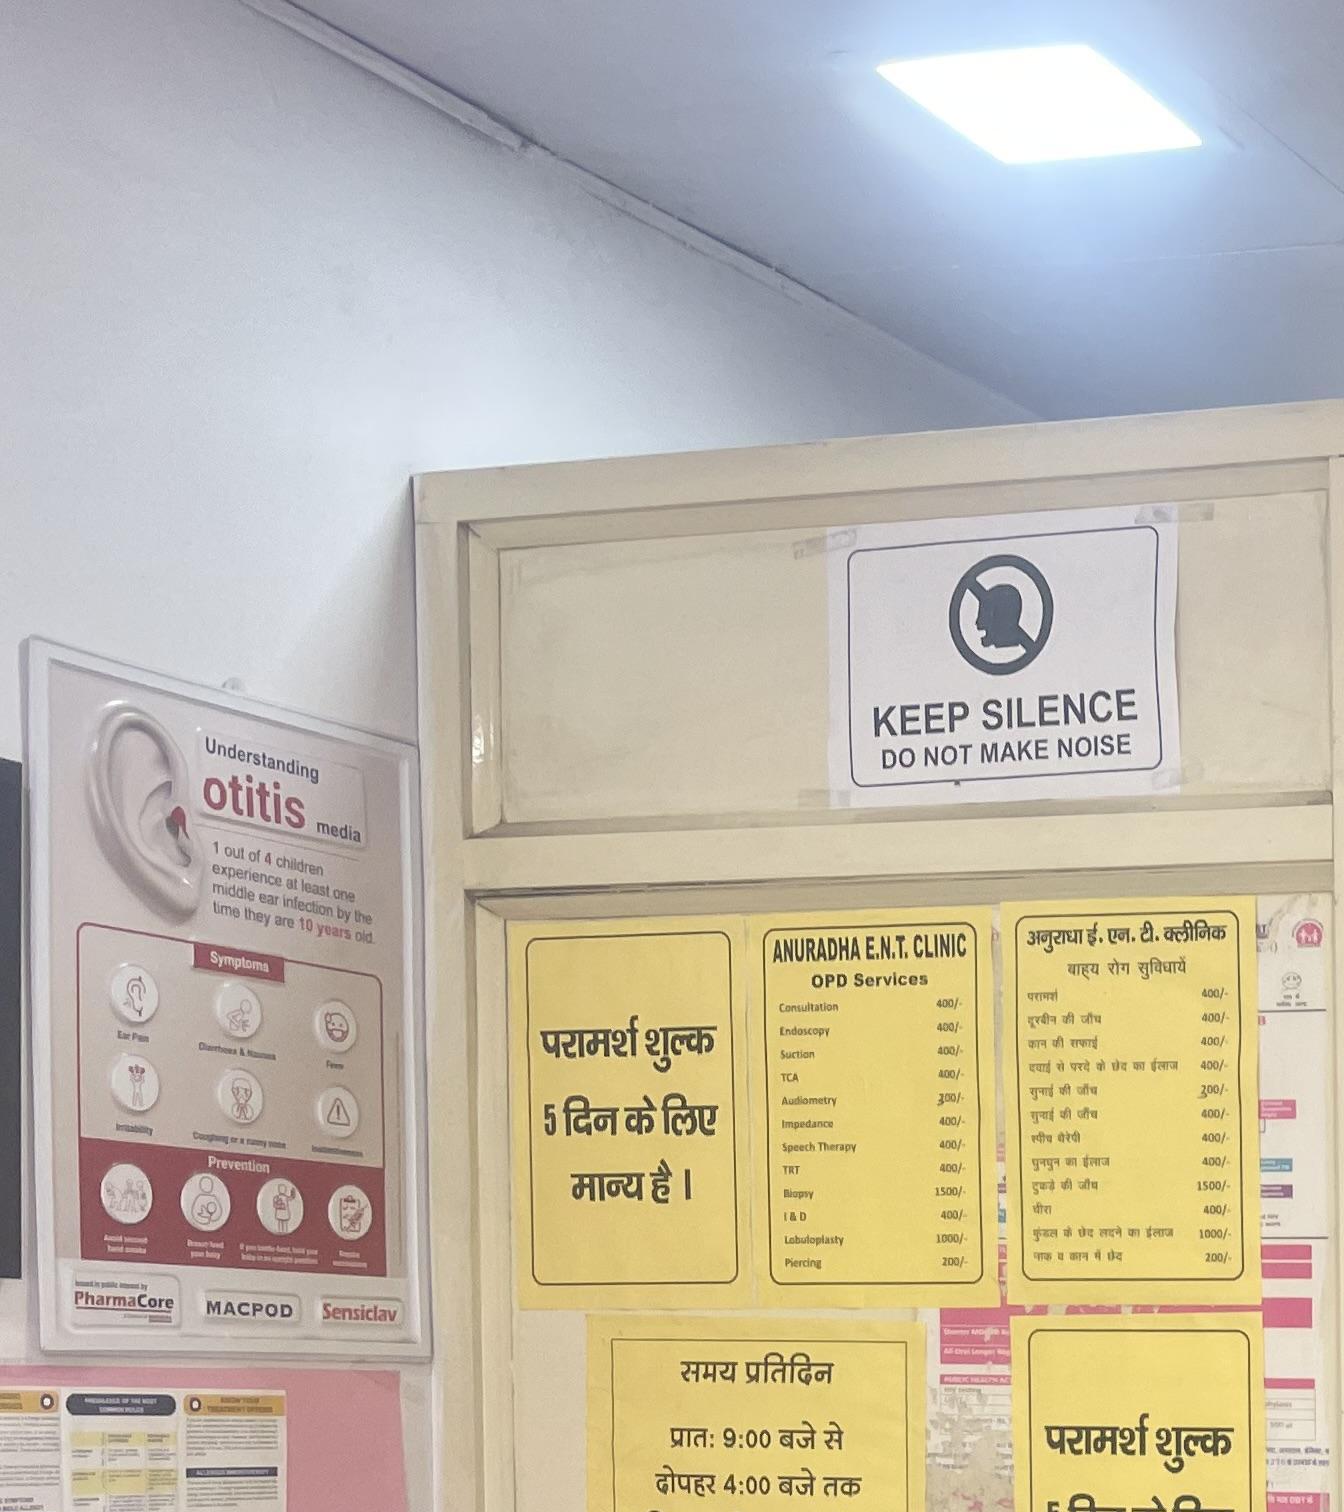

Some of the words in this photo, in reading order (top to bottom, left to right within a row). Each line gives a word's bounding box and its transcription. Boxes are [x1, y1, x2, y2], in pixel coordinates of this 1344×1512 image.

[874, 702, 969, 737] KEEP
[983, 689, 1137, 730] SILENCE
[206, 737, 319, 784] Understanding
[882, 748, 915, 769] DO
[925, 744, 972, 766] NOT
[981, 740, 1048, 763] MAKE
[1058, 734, 1131, 758] NOISE
[204, 775, 305, 828] otitis
[317, 821, 361, 842] media
[213, 842, 219, 853] 1
[224, 846, 244, 859] out
[249, 850, 262, 862] of
[265, 853, 271, 864] 4
[276, 857, 323, 876] children
[213, 864, 282, 887] experience
[287, 878, 297, 889] at
[301, 880, 330, 897] least
[333, 889, 355, 902] one
[213, 882, 255, 900] middle
[259, 892, 278, 905] ear
[283, 895, 333, 916] infection
[337, 908, 351, 923] by
[355, 911, 372, 924] the
[213, 902, 240, 918] time
[245, 908, 270, 927] they
[275, 915, 294, 928] are
[299, 918, 313, 931] 10
[317, 922, 351, 939] years
[773, 937, 860, 962] ANURADHA
[866, 936, 908, 960] E.N.T.
[914, 933, 966, 958] CLINIC
[1027, 929, 1083, 953] अनुराधा
[1164, 920, 1226, 942] क्लीनिक
[210, 951, 269, 973] Symptoms
[1108, 958, 1129, 975] रोग
[812, 974, 847, 988] OPD
[854, 972, 928, 987] Services
[779, 1002, 838, 1013] Consultation
[780, 1026, 829, 1038] Endoscopy
[540, 1015, 638, 1058] परामर्श
[645, 1026, 717, 1073] शुल्क
[781, 1050, 814, 1059] Suction
[781, 1073, 798, 1082] TCA
[782, 1097, 837, 1107] Audiometry
[544, 1104, 556, 1135] 5
[563, 1095, 619, 1136] दिन
[624, 1095, 657, 1135] के
[661, 1093, 718, 1136] लिए
[782, 1120, 833, 1129] Impedance
[782, 1143, 815, 1152] Speech
[819, 1142, 856, 1152] Therapy
[208, 1155, 270, 1174] Prevention
[783, 1166, 800, 1174] TRT
[571, 1173, 645, 1201] मान्य
[784, 1189, 813, 1199] Biopsy
[785, 1235, 844, 1246] Lobuloplasty
[785, 1258, 821, 1269] Piercing
[75, 1291, 174, 1309] PharmaCore
[206, 1300, 293, 1318] MACPOD
[322, 1303, 397, 1322] Sensiclav
[681, 1361, 738, 1383] समय
[746, 1352, 834, 1385] प्रतिदिन
[724, 1428, 771, 1448] 9:00
[779, 1421, 816, 1449] बजे
[824, 1422, 844, 1450] से
[1045, 1413, 1149, 1455] परामर्श
[1156, 1427, 1234, 1473] शुल्क
[655, 1465, 716, 1497] दोपहर
[724, 1474, 770, 1494] 4:00
[778, 1468, 816, 1496] बजे
[823, 1477, 862, 1496] तक
